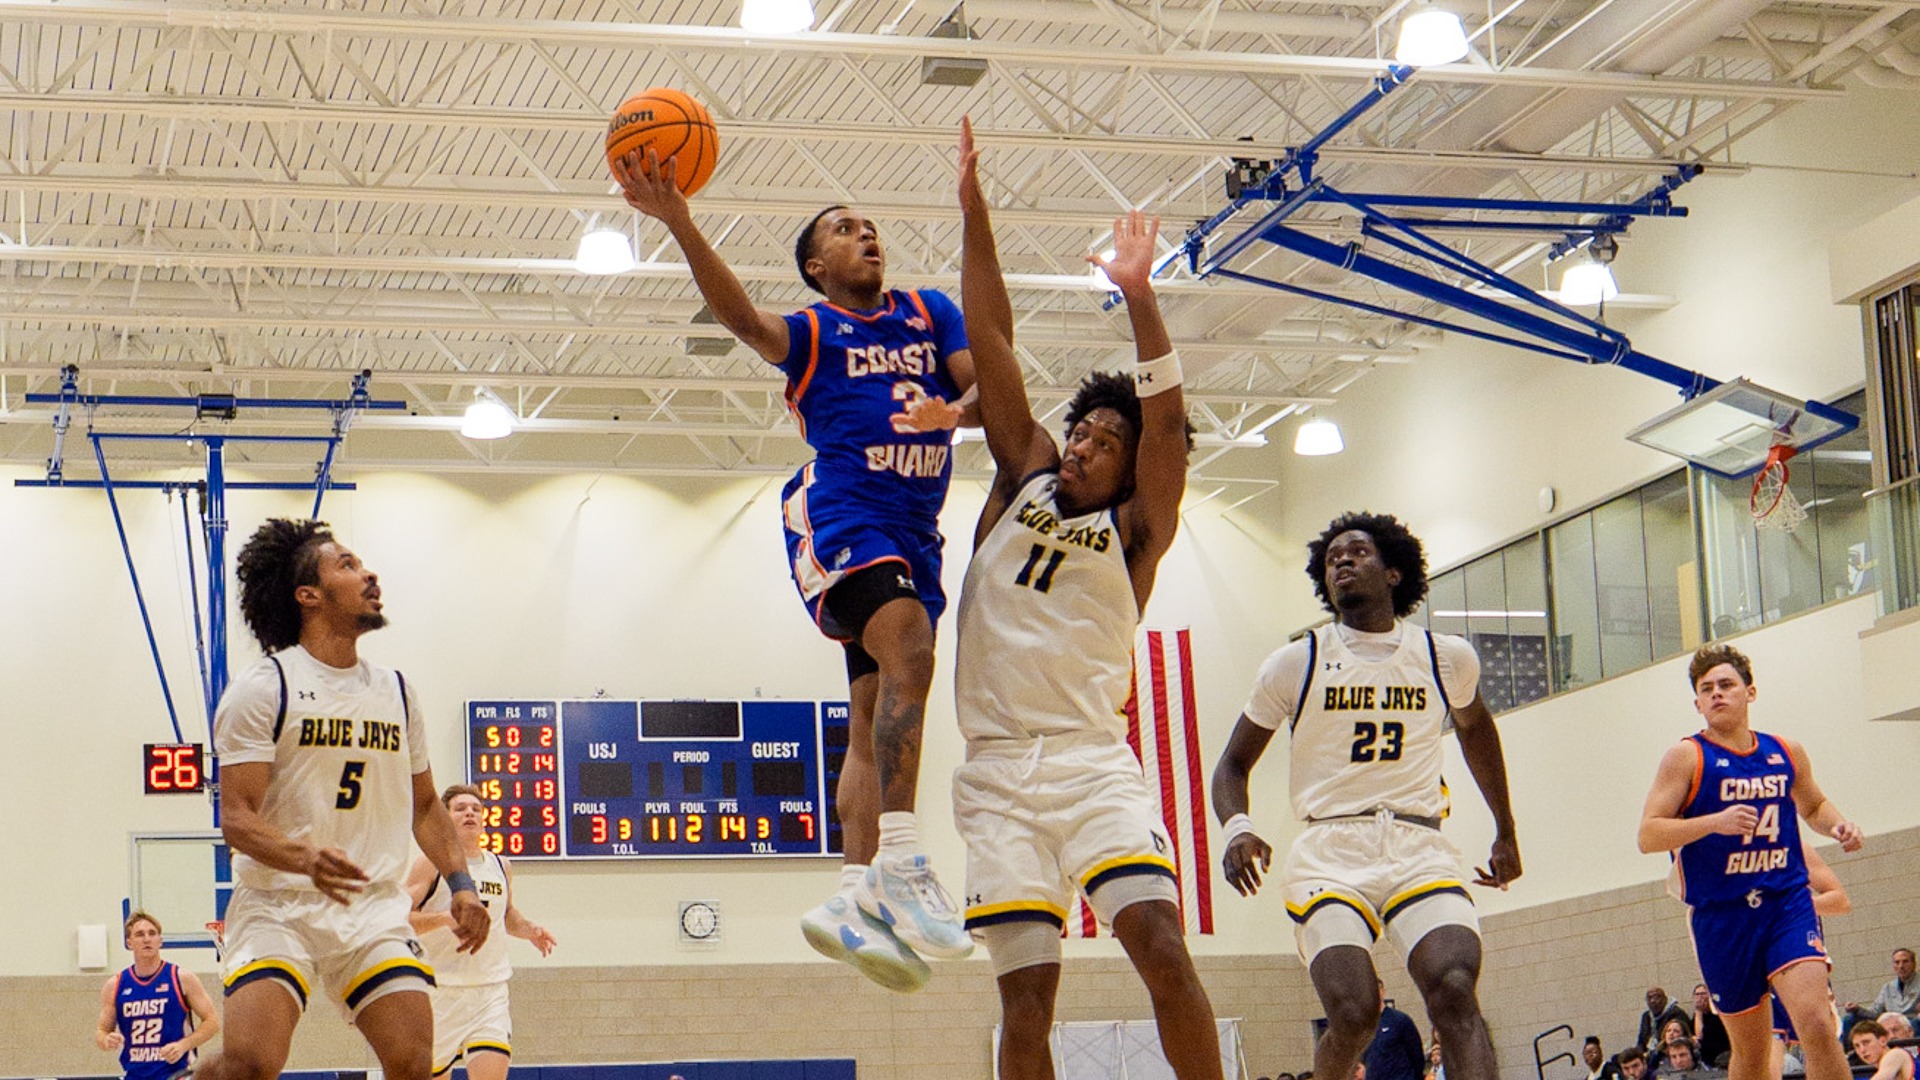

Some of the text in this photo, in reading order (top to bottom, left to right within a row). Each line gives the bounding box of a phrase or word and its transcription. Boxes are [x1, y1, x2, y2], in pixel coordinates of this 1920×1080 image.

[609, 110, 654, 133] ilson
[846, 341, 938, 378] COAST
[892, 380, 928, 434] 3
[865, 444, 949, 478] GUARD
[1013, 500, 1111, 554] LUE JAYS
[1014, 542, 1068, 594] 11
[1323, 686, 1428, 711] BLUE JAYS
[475, 706, 548, 719] PLYR FLS PTS
[827, 706, 848, 719] PLYR
[299, 717, 401, 753] BLUE JAYS
[486, 725, 553, 748] 5 0 2
[1350, 721, 1406, 763] 23
[588, 743, 617, 759] USJ
[673, 751, 710, 764] PERIOD
[752, 742, 800, 758] GUEST
[150, 748, 197, 789] 26
[480, 752, 554, 774] 11 2 14
[335, 760, 367, 811] 5
[481, 778, 554, 801] 15 1 13
[1720, 774, 1788, 802] COAST
[509, 804, 522, 828] 2
[542, 804, 556, 828] 5
[573, 803, 607, 815] FOULS
[645, 802, 738, 814] PLYR FOUL PTS
[780, 801, 813, 813] FOULS
[591, 814, 608, 844] 3
[619, 817, 632, 841] 3
[651, 814, 746, 843] 11 2 14
[757, 816, 770, 840] 3
[798, 813, 815, 841] 7
[508, 832, 524, 855] 0
[541, 832, 557, 855] 0
[612, 843, 638, 855] T.O.L.
[751, 842, 777, 854] T.O.L.
[479, 881, 502, 896] JAYS
[122, 998, 169, 1018] COAST
[131, 1018, 163, 1045] 22
[129, 1047, 166, 1062] GUAR
